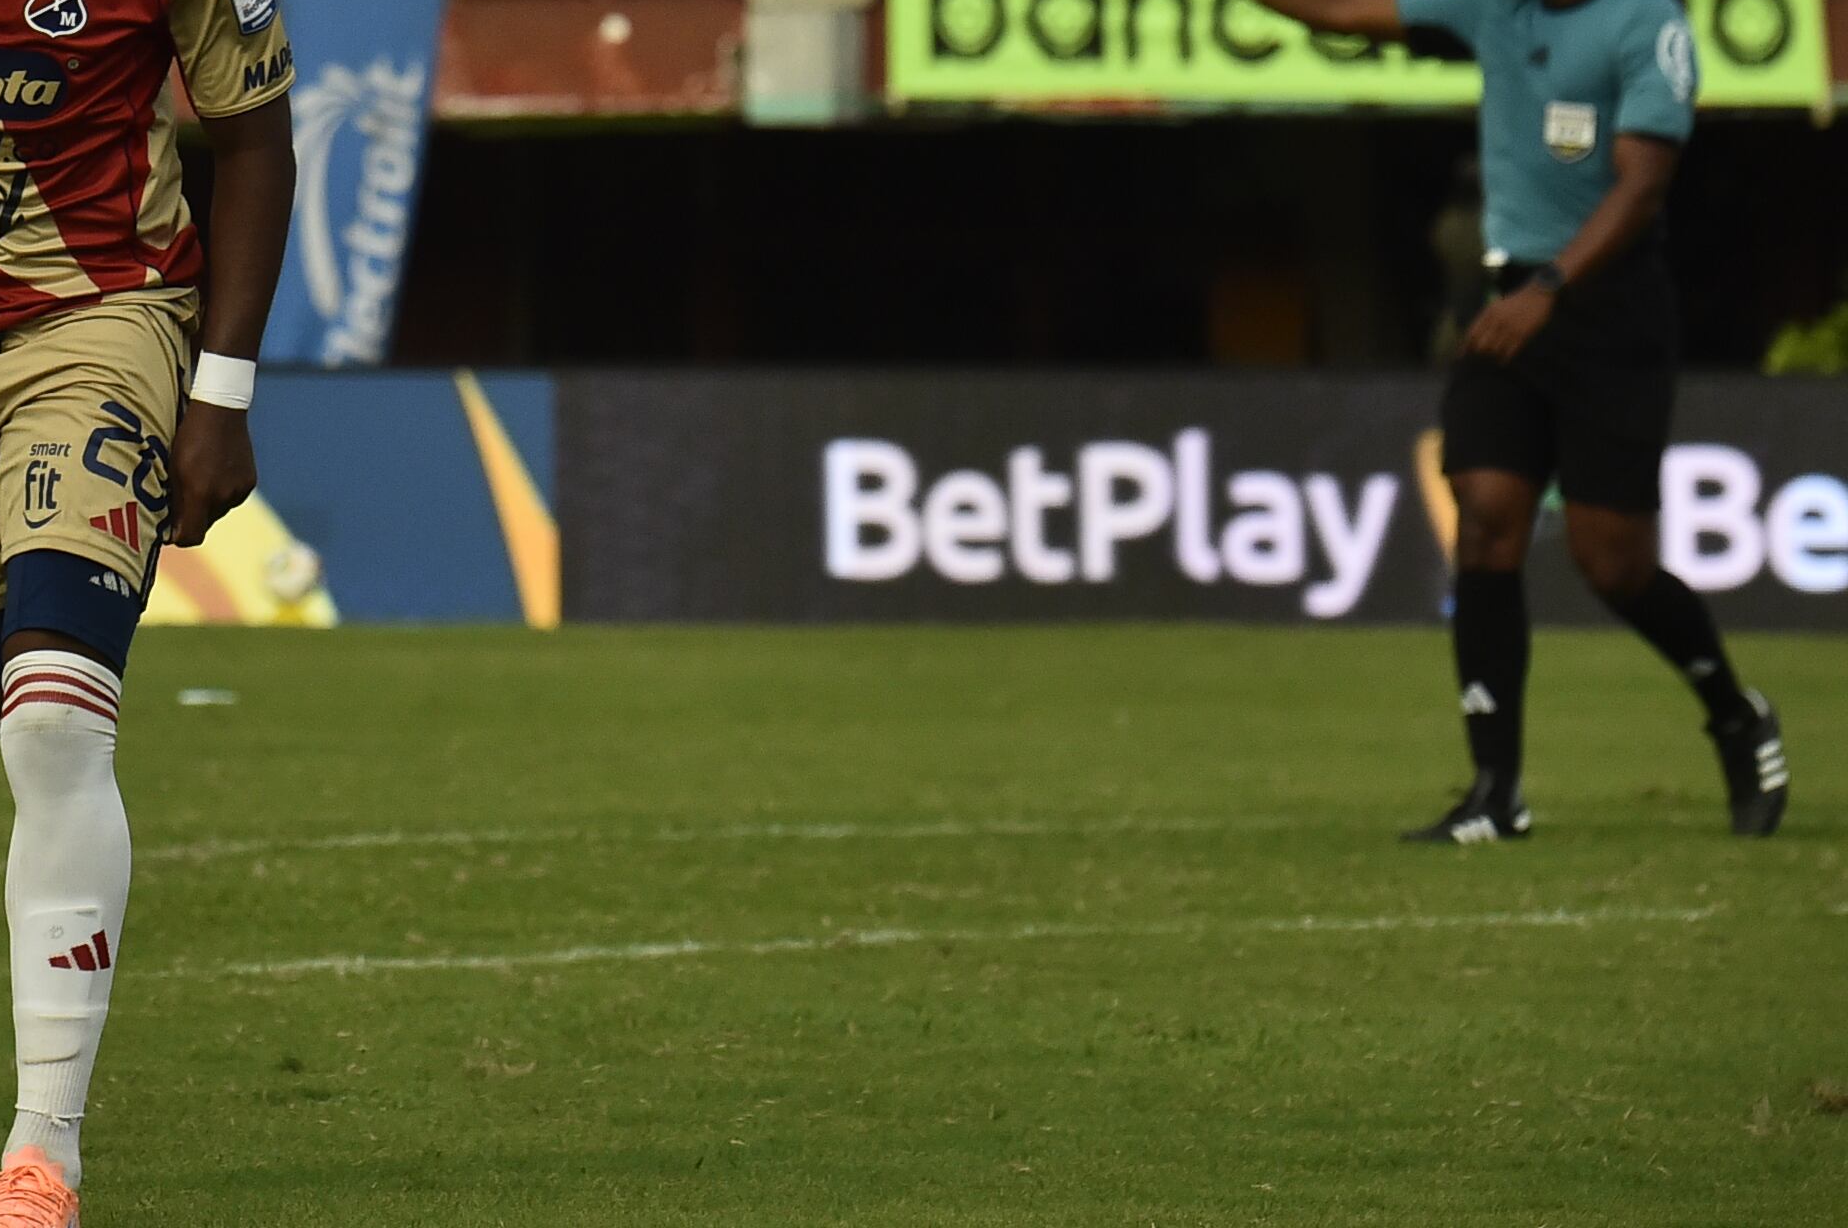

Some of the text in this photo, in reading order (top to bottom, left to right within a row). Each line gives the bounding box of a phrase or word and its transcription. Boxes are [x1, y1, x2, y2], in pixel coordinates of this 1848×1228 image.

[25, 460, 62, 511] fit
[29, 442, 72, 458] smart
[822, 427, 1400, 619] BetPlay
[1657, 441, 1848, 593] Be
